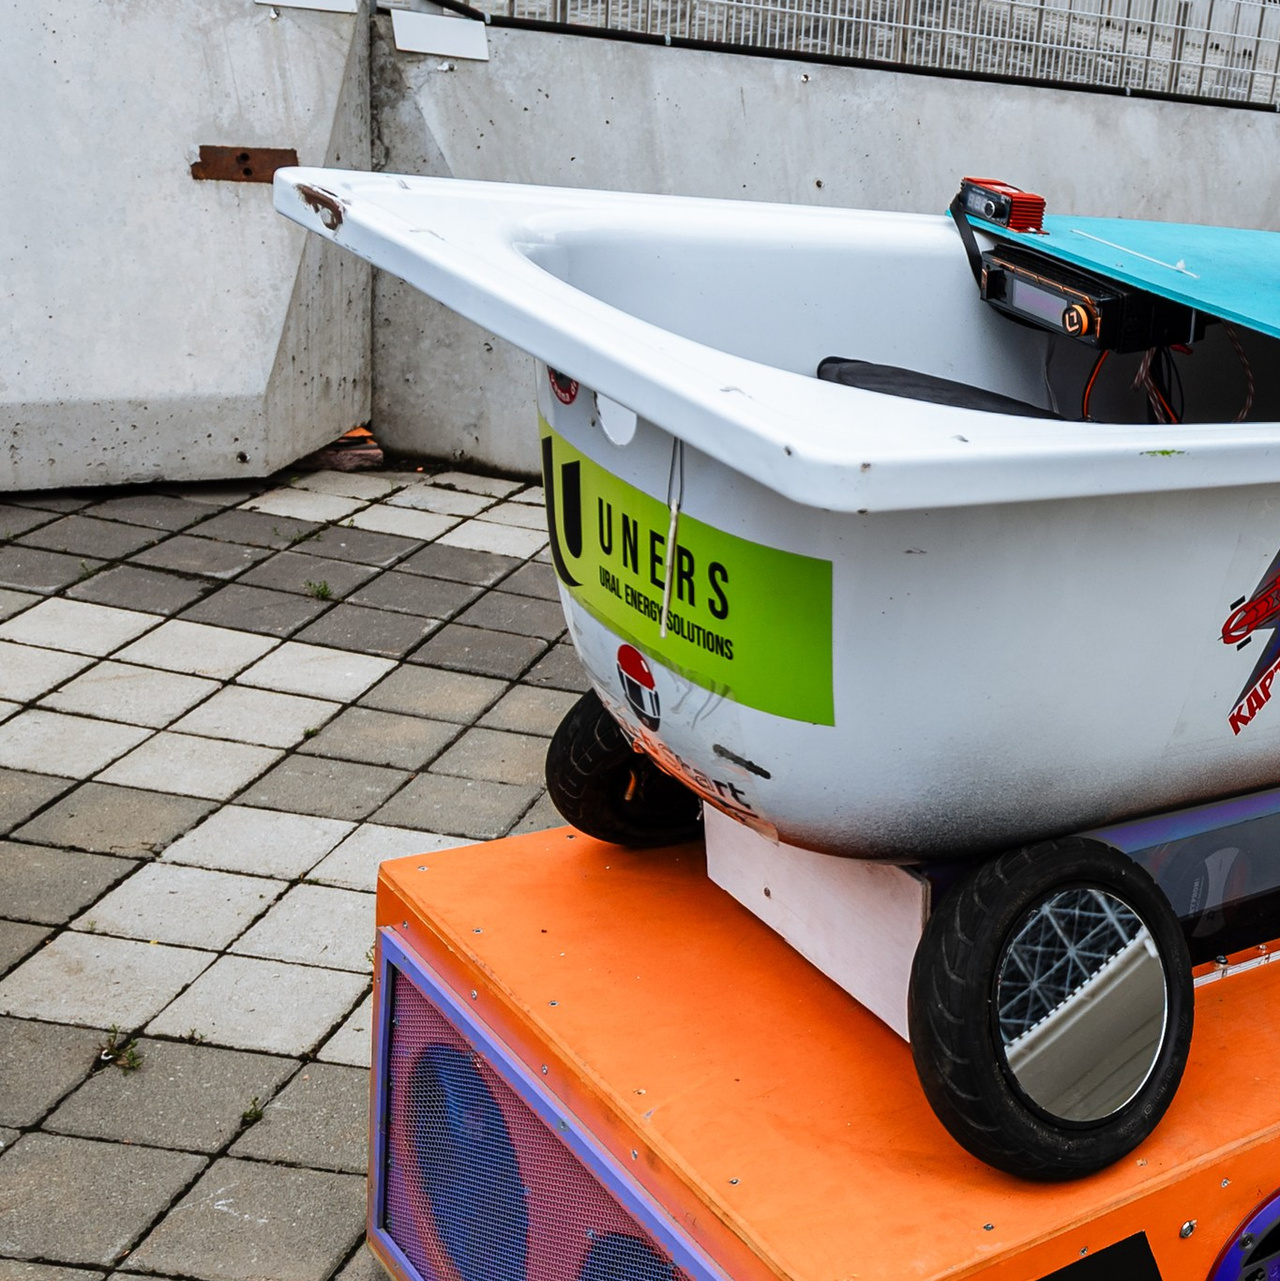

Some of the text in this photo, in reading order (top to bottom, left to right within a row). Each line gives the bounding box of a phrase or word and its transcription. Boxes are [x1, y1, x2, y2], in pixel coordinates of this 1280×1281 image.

[598, 497, 730, 621] UNERS
[599, 565, 735, 661] URAL ENERGY SOLUTIONS
